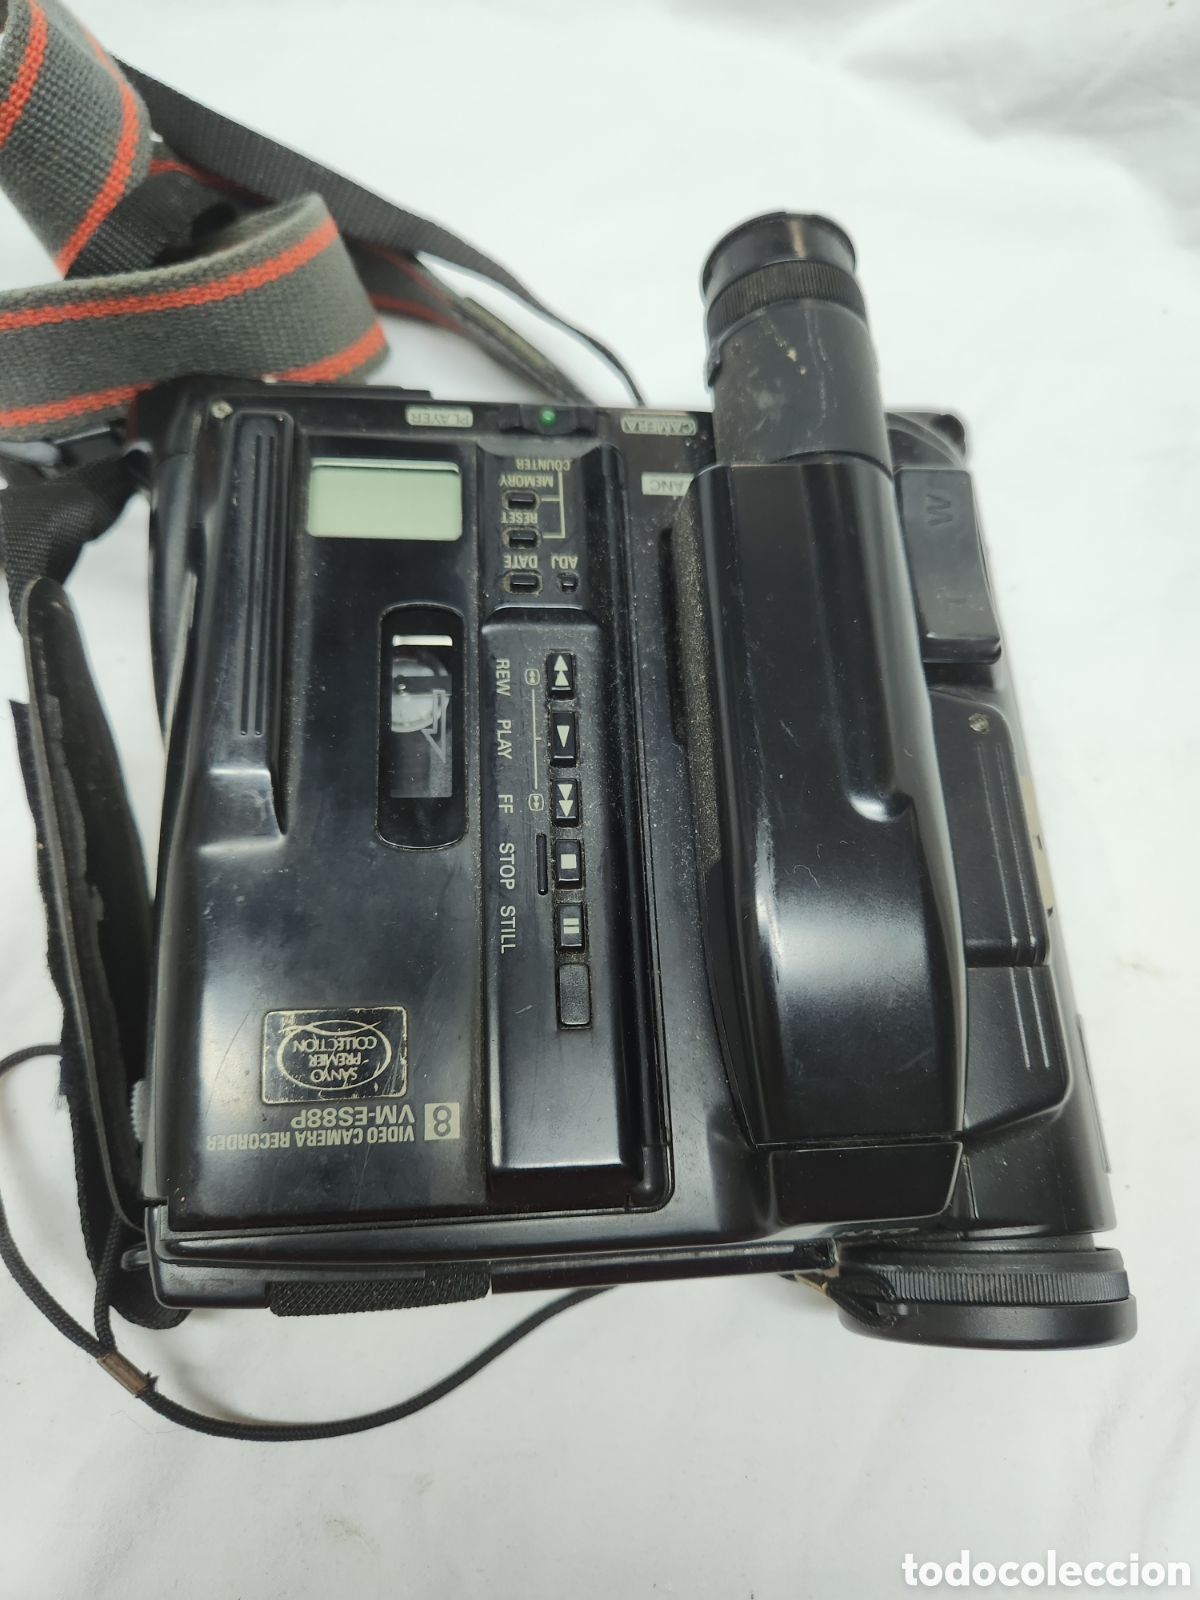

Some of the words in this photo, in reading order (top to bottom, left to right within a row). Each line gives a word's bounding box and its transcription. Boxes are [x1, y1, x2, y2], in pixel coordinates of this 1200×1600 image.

[410, 411, 470, 426] PLAYER
[624, 418, 696, 434] CAMERA
[515, 458, 571, 472] COUNTER
[499, 475, 554, 488] MEMORY
[650, 478, 689, 492] ANC
[500, 511, 538, 524] RESET
[503, 555, 538, 569] DATE
[551, 555, 578, 570] ADJ
[496, 658, 511, 696] REW
[497, 719, 512, 760] PLAY
[498, 793, 514, 815] FF
[499, 842, 516, 890] STOP
[500, 905, 516, 955] STILL
[293, 1035, 377, 1053] COLLECTION
[308, 1051, 361, 1067] PREMIER
[310, 1066, 359, 1083] SANYO
[291, 1103, 415, 1129] VM-ES88P
[431, 1104, 454, 1138] 8
[206, 1131, 291, 1151] RECORDER
[295, 1127, 361, 1147] CAMERA
[367, 1125, 415, 1143] VIDEO
